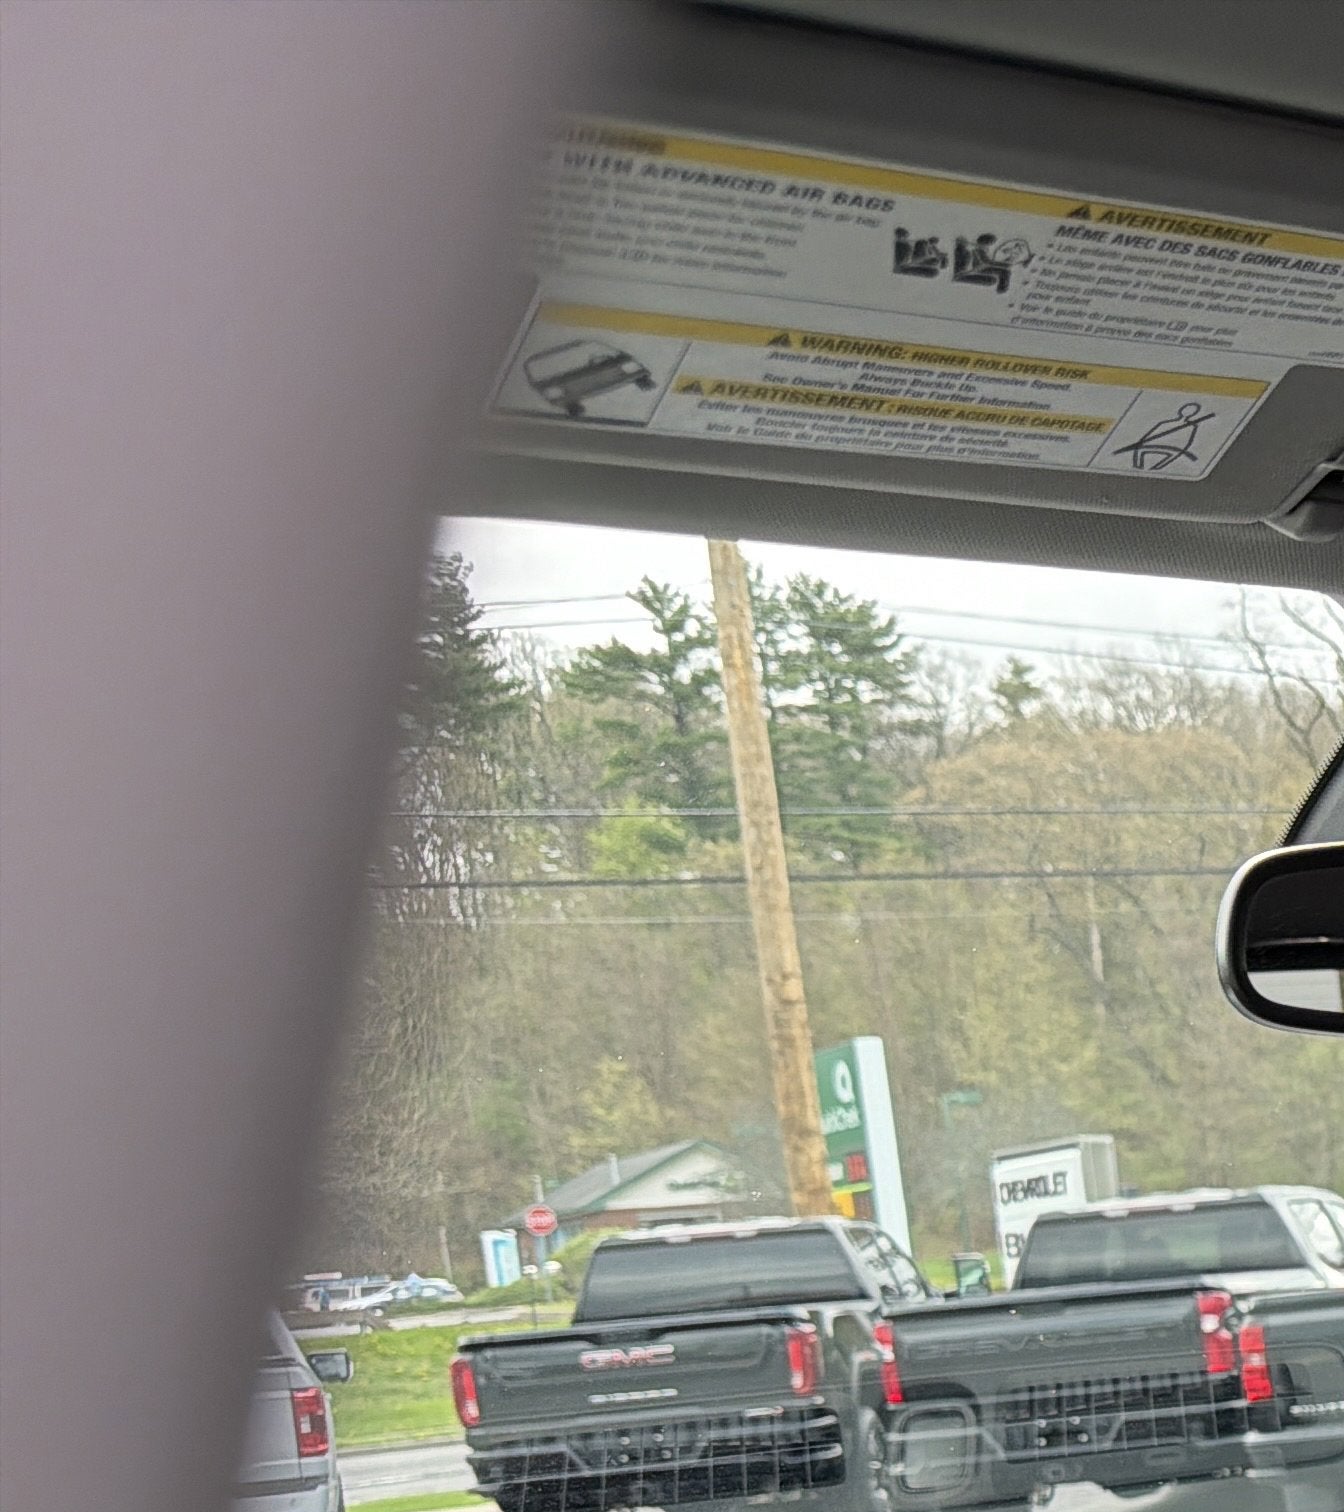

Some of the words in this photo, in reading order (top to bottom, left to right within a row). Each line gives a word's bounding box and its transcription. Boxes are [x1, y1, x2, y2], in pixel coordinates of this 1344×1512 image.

[639, 163, 777, 195] ADVANCED
[781, 183, 826, 201] AIR
[831, 190, 896, 213] BAGS
[1099, 210, 1273, 246] AVERTISSEMENT
[1110, 233, 1158, 250] AVEC
[1157, 239, 1194, 256] DES
[1193, 246, 1240, 263] SACS
[1240, 252, 1341, 276] GONFLABLES
[999, 1171, 1068, 1205] CHEVROLET
[578, 1343, 676, 1371] GMC
